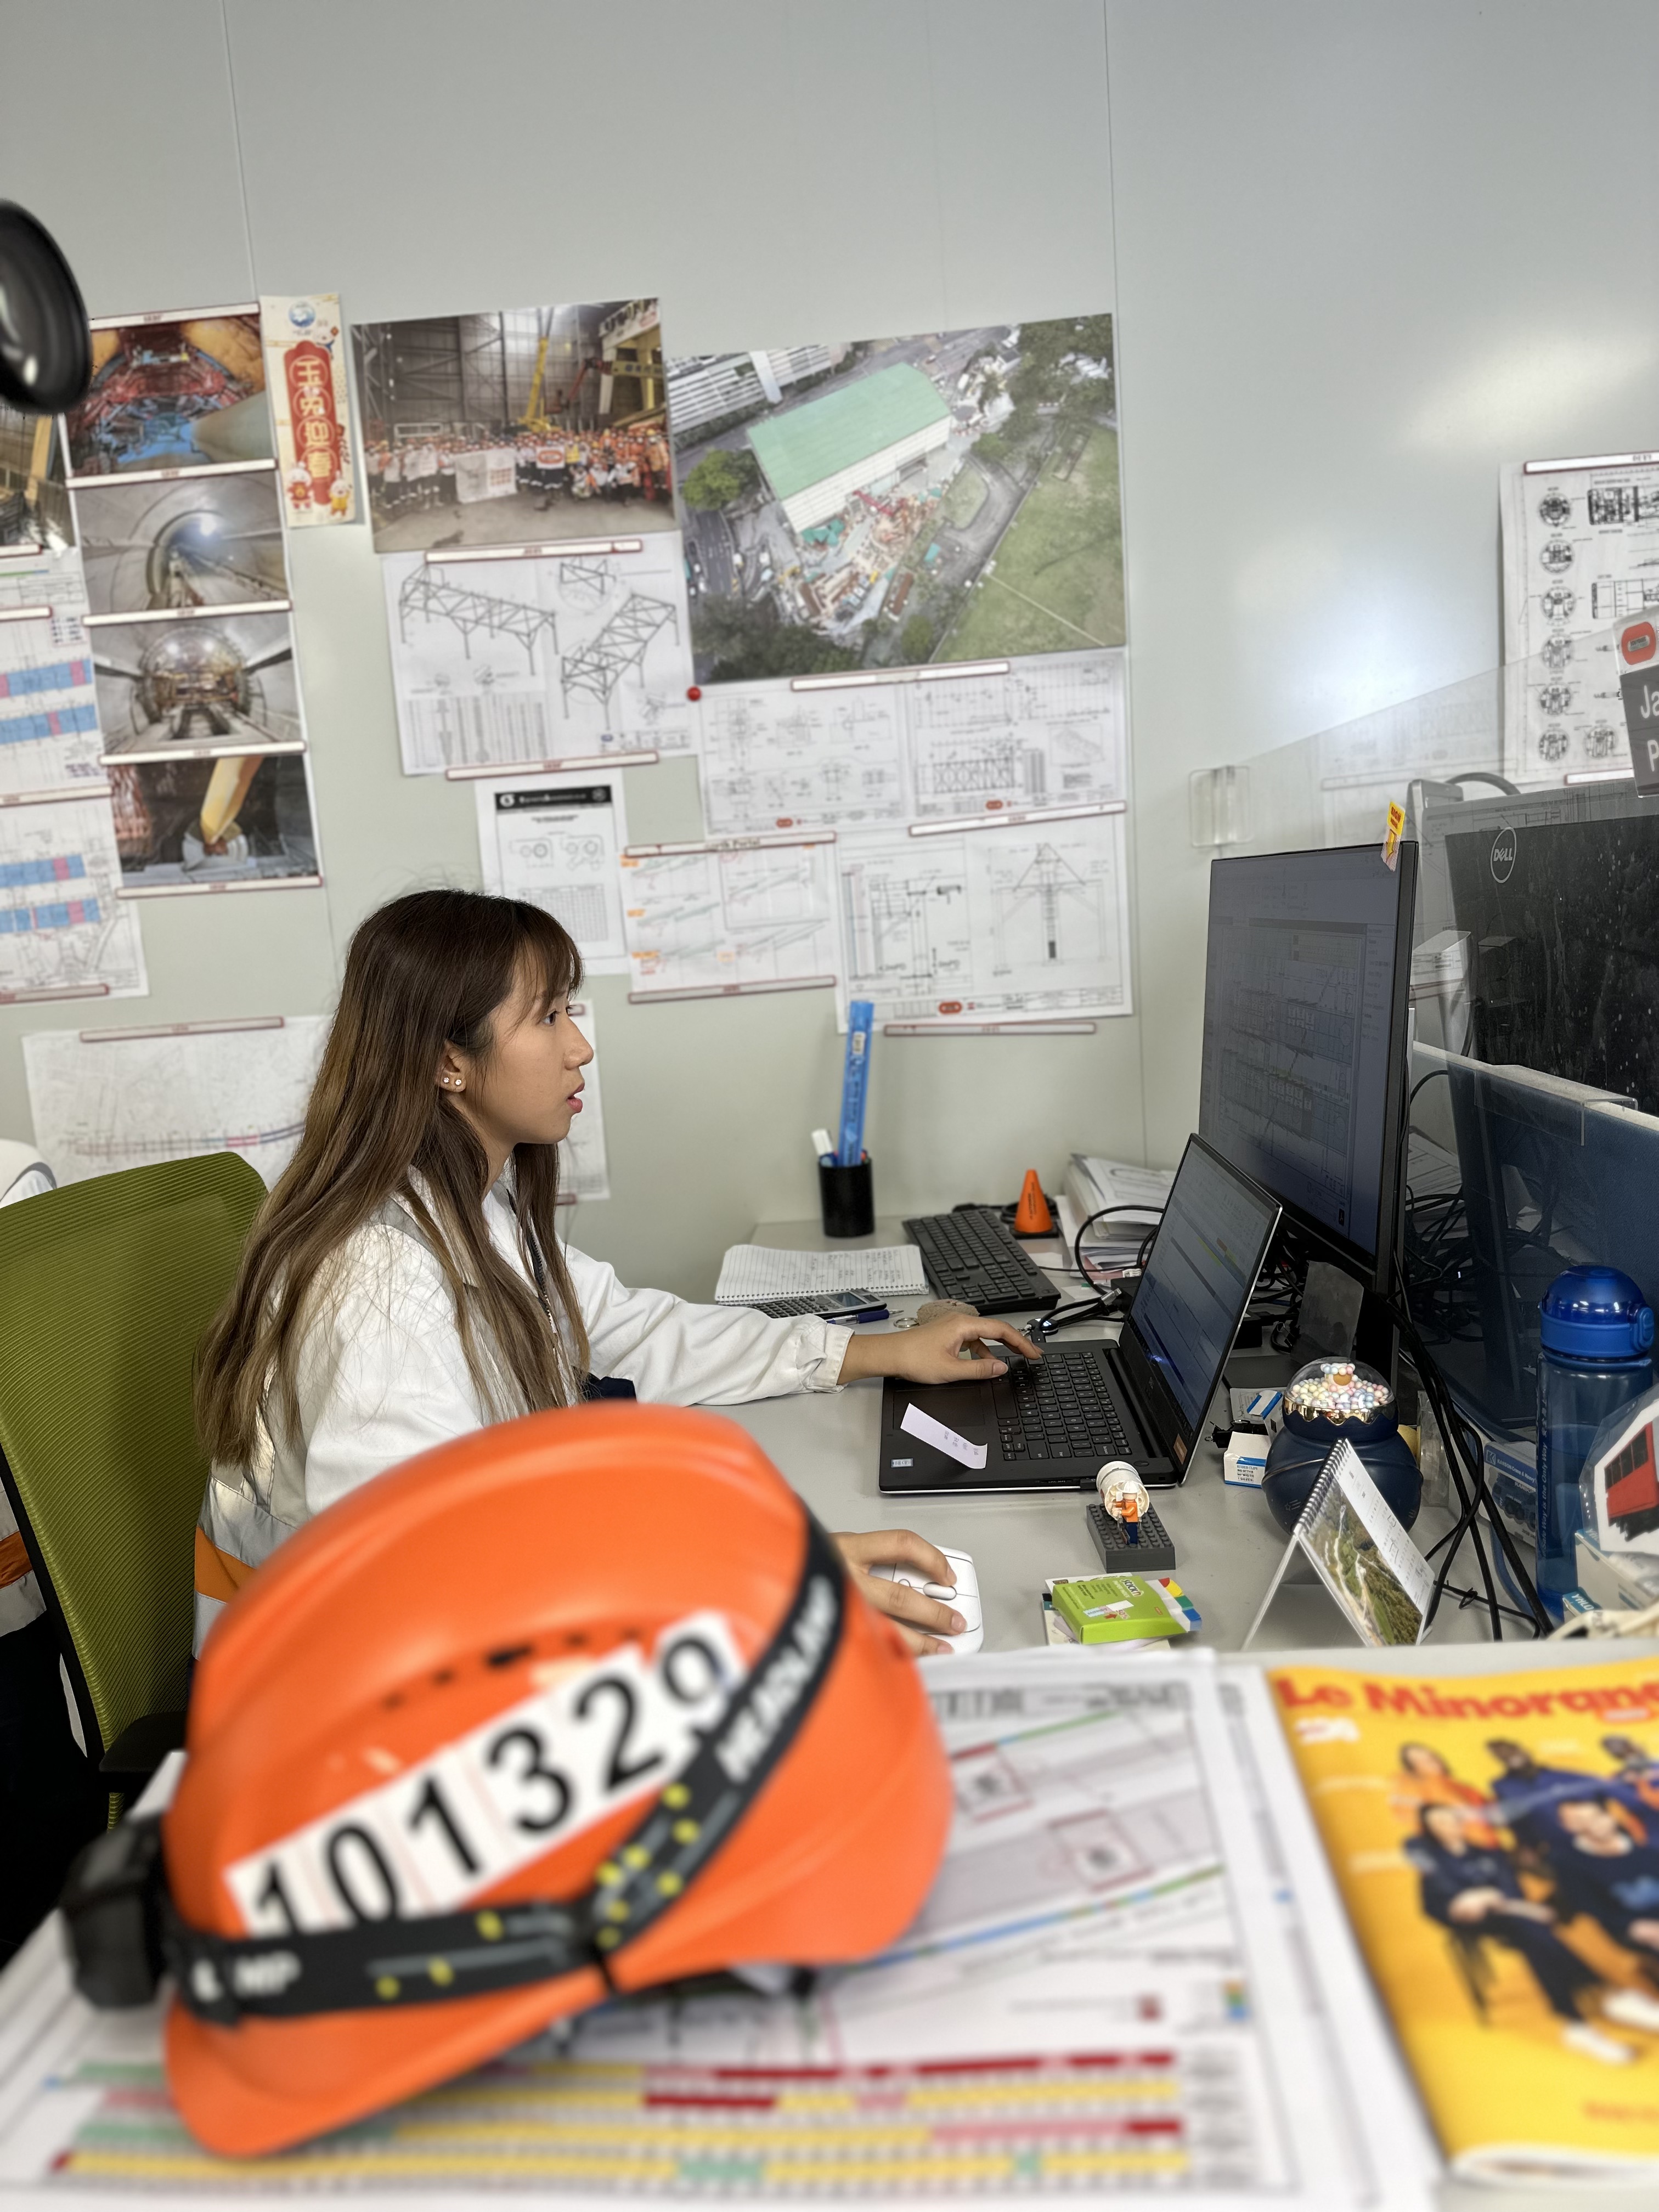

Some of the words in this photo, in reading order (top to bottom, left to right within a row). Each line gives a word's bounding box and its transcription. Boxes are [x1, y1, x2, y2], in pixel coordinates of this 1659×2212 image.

[1493, 847, 1513, 862] DELL
[1571, 1593, 1595, 1610] YHLO
[1274, 1678, 1353, 1708] Le
